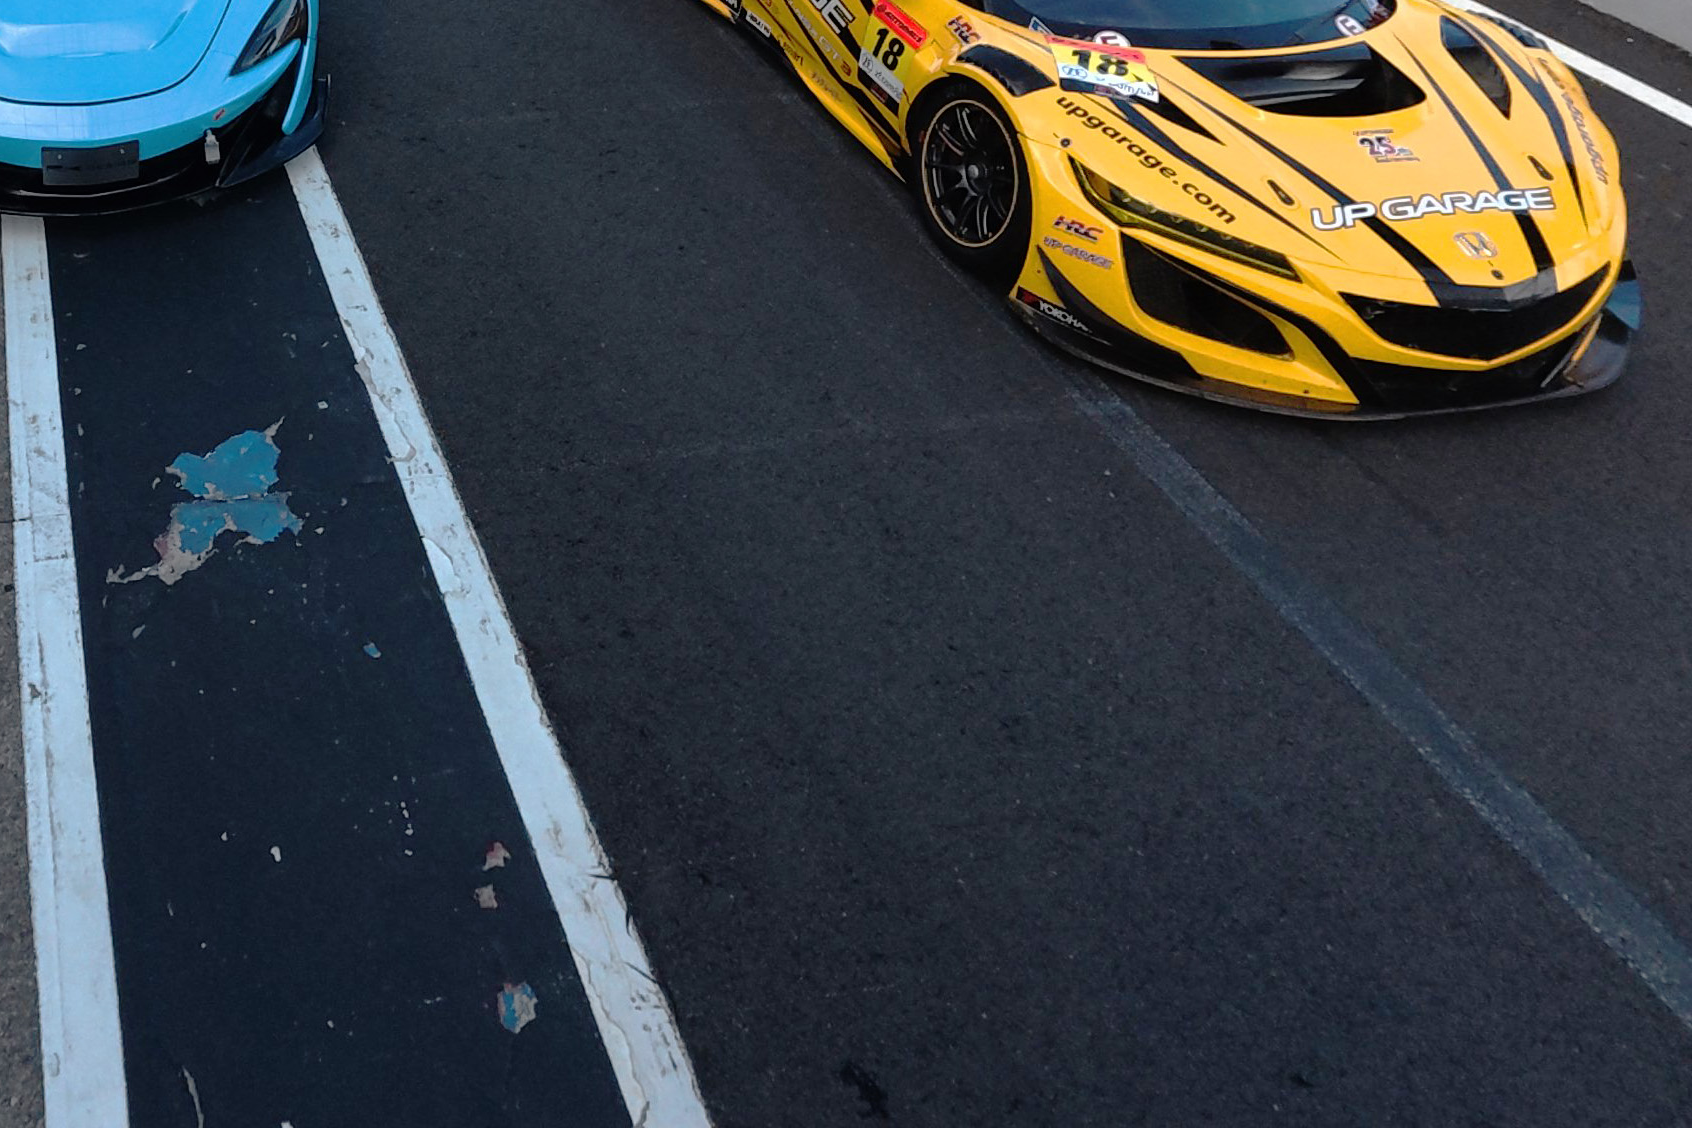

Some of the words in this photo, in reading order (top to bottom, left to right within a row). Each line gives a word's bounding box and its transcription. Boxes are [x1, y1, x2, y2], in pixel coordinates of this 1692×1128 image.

[872, 28, 905, 71] 18
[1071, 49, 1130, 77] 18
[1056, 95, 1237, 225] upgarage.com
[1053, 215, 1104, 243] HRC
[1311, 201, 1377, 232] UP
[1380, 186, 1557, 223] GARAGE
